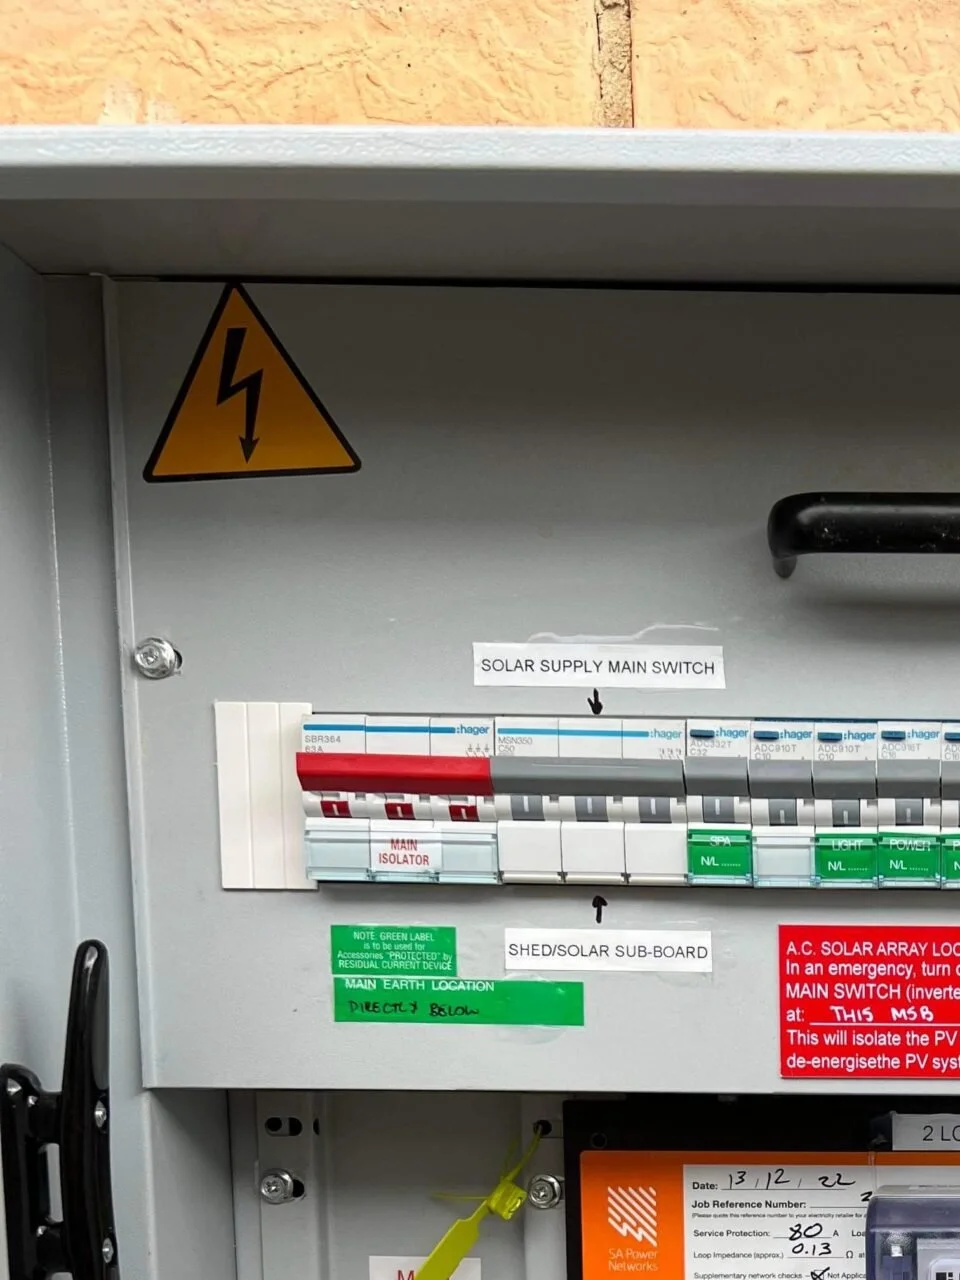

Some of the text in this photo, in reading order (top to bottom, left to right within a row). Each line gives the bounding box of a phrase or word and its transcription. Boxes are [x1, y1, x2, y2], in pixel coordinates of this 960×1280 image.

[481, 658, 715, 675] SOLAR SUPPLY MAIN SWITCH
[390, 838, 418, 851] MAIN
[709, 836, 732, 847] SPA
[832, 839, 864, 851] LIGHT
[889, 838, 931, 852] POWER
[379, 853, 430, 866] ISOLATOR
[379, 932, 407, 941] GREEN
[409, 932, 435, 942] LABEL
[508, 943, 709, 959] SHED/SOLAR SUB-BOARD
[786, 941, 815, 956] A.C.
[821, 941, 874, 957] SOLAR
[876, 941, 928, 957] ARRAY
[338, 960, 452, 971] RESIDUAL CURRENT DEVICE
[786, 960, 800, 975] In
[804, 964, 823, 976] an
[828, 963, 917, 979] emergency,
[921, 962, 950, 977] turn
[344, 978, 495, 992] MAIN EARTH LOCATION
[786, 983, 829, 999] MAIN
[834, 984, 901, 1000] SWITCH
[786, 1008, 804, 1021] at:
[830, 1005, 934, 1023] THIS MSB
[787, 1031, 819, 1046] This
[823, 1031, 847, 1046] will
[852, 1031, 901, 1046] isolate
[906, 1031, 930, 1046] the
[934, 1031, 957, 1046] PV
[787, 1054, 901, 1072] de-energisethe
[905, 1054, 928, 1069] PV
[922, 1126, 934, 1142] 2
[692, 1181, 718, 1191] Date:
[691, 1200, 806, 1210] Job Reference Number:
[693, 1229, 770, 1238] Service Protection:
[788, 1223, 823, 1241] 80
[608, 1248, 658, 1260] SA Power
[791, 1242, 832, 1256] 0.13
[608, 1261, 658, 1271] Networks
